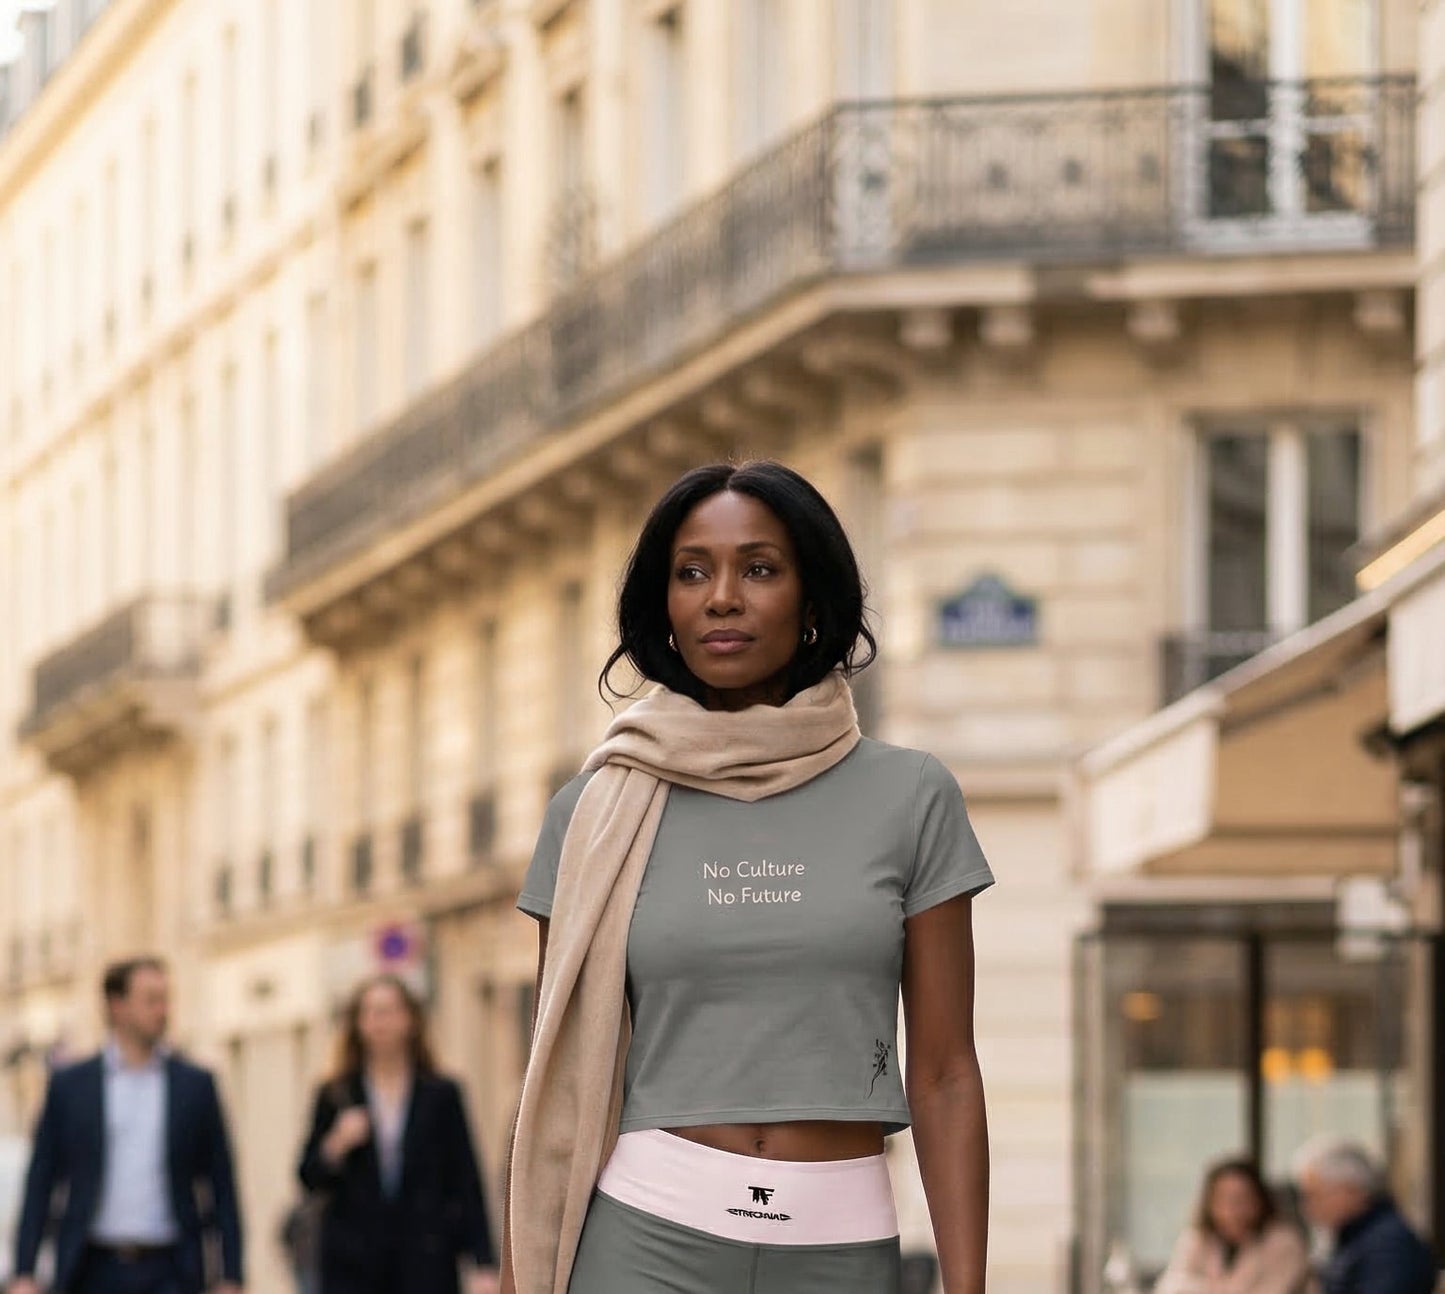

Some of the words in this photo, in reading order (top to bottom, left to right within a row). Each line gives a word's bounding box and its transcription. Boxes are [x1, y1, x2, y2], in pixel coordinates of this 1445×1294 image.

[703, 861, 731, 879] No
[736, 859, 805, 878] Culture
[708, 888, 735, 905] No
[741, 887, 802, 904] Future
